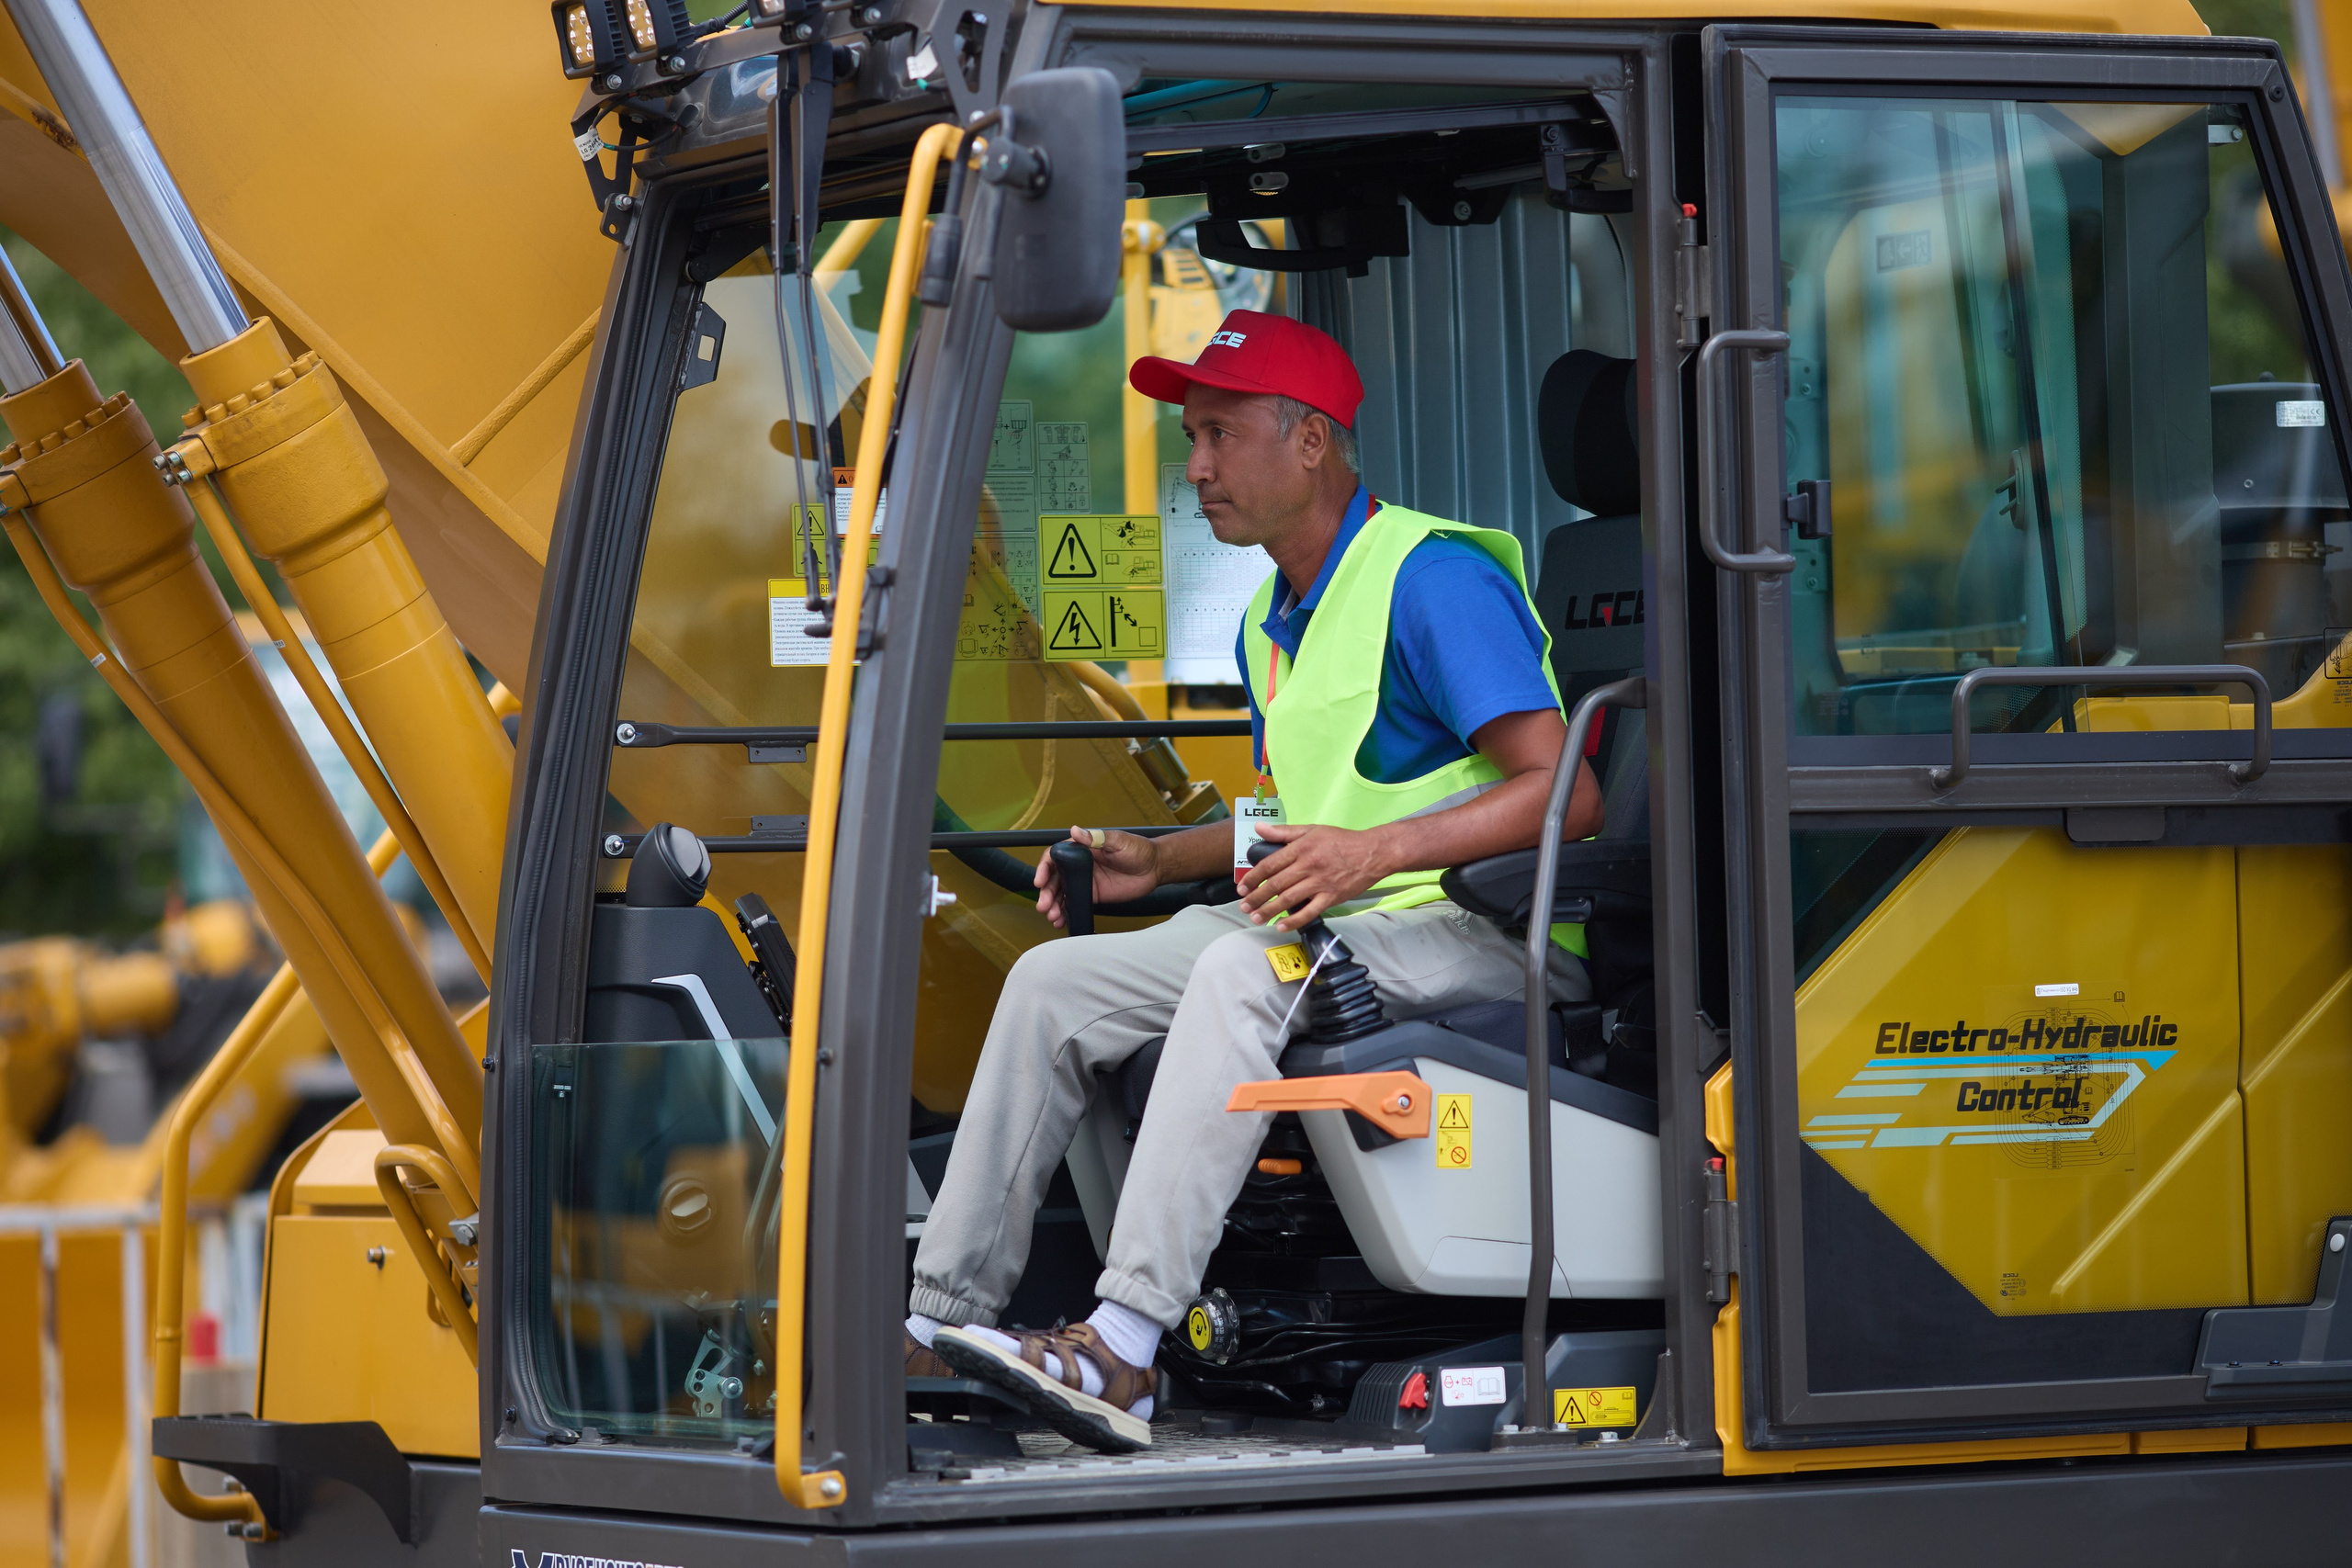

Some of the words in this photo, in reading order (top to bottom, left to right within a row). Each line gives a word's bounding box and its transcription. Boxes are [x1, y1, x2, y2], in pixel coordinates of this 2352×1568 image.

[1245, 808, 1279, 817] LGCE
[1875, 1015, 2178, 1055] Electro-Hydraulic
[1956, 1078, 2083, 1112] Control
